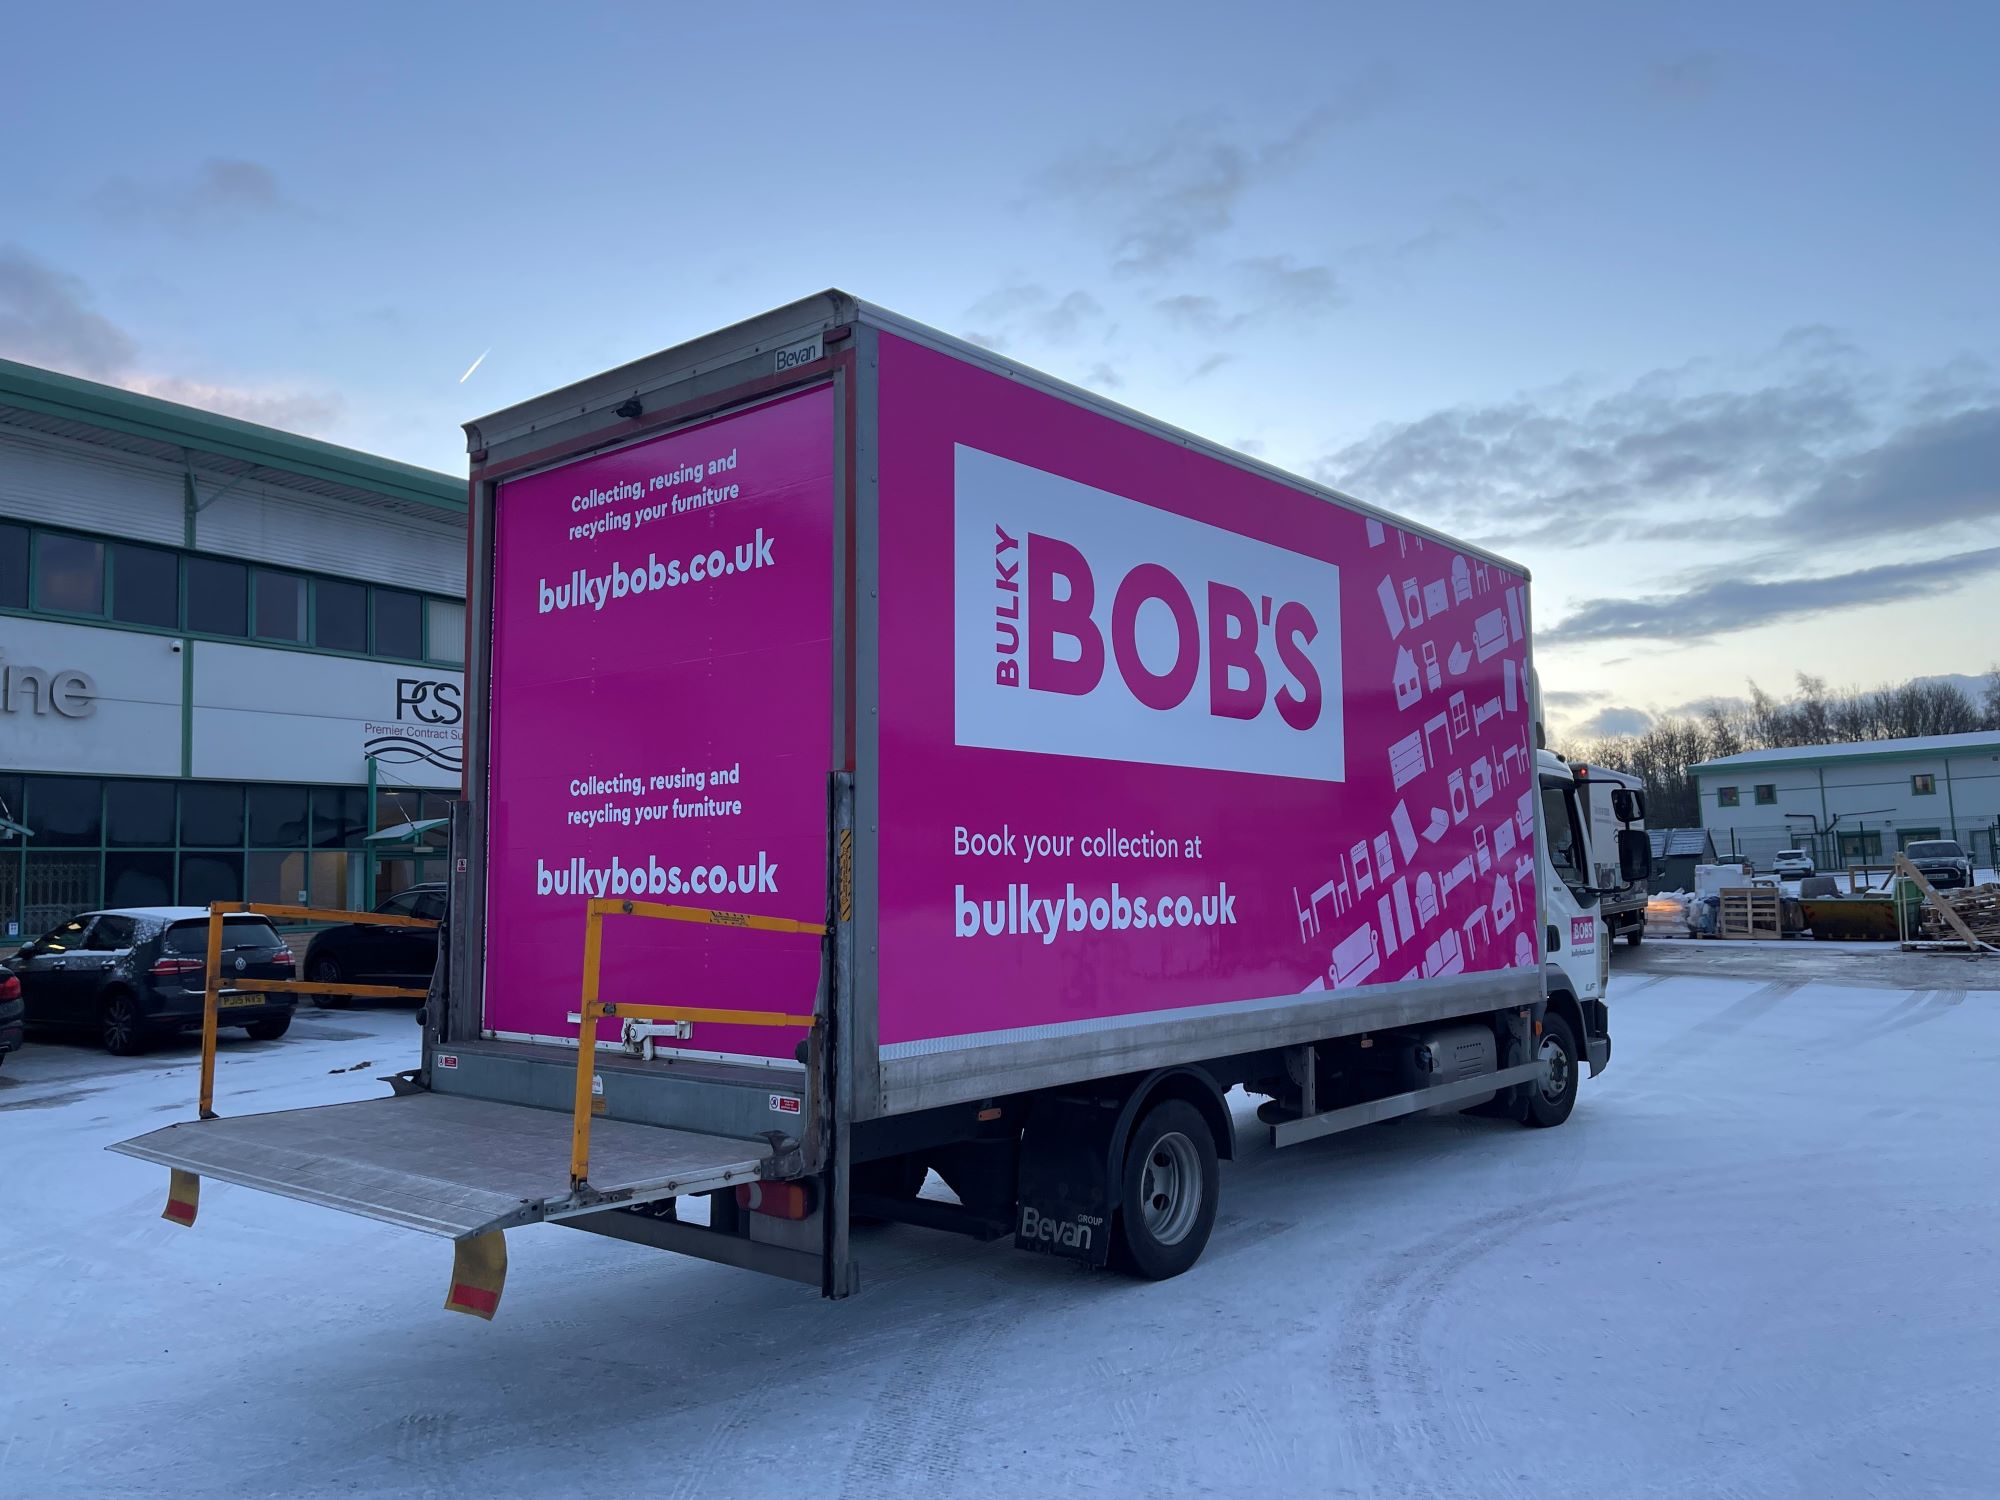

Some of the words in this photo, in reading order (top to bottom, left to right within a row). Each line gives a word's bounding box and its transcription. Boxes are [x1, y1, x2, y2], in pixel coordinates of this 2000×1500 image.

[776, 344, 816, 371] Bevan
[571, 480, 646, 513] Collecting,
[649, 463, 704, 492] reusing
[707, 447, 737, 475] and
[569, 510, 631, 541] recycling
[634, 502, 668, 528] your
[671, 484, 740, 514] furniture
[539, 527, 775, 614] bulkybobs.co.uk
[995, 523, 1019, 688] BULKY
[1027, 532, 1322, 731] BOB'S
[397, 678, 462, 725] PCS
[364, 722, 404, 736] Premier
[406, 726, 448, 739] Contract
[569, 772, 646, 798] Collecting,
[650, 767, 706, 792] reusing
[709, 762, 740, 786] and
[567, 802, 631, 828] recycling
[634, 805, 669, 826] your
[672, 795, 742, 819] furniture
[954, 824, 1017, 857] Book
[1023, 834, 1075, 864] your
[1080, 827, 1179, 859] collection
[1184, 834, 1203, 859] at
[537, 850, 779, 899] bulkybobs.co.uk
[955, 881, 1237, 945] bulkybobs.co.uk
[1021, 1206, 1092, 1250] Bevan
[1077, 1213, 1104, 1227] GROUP
